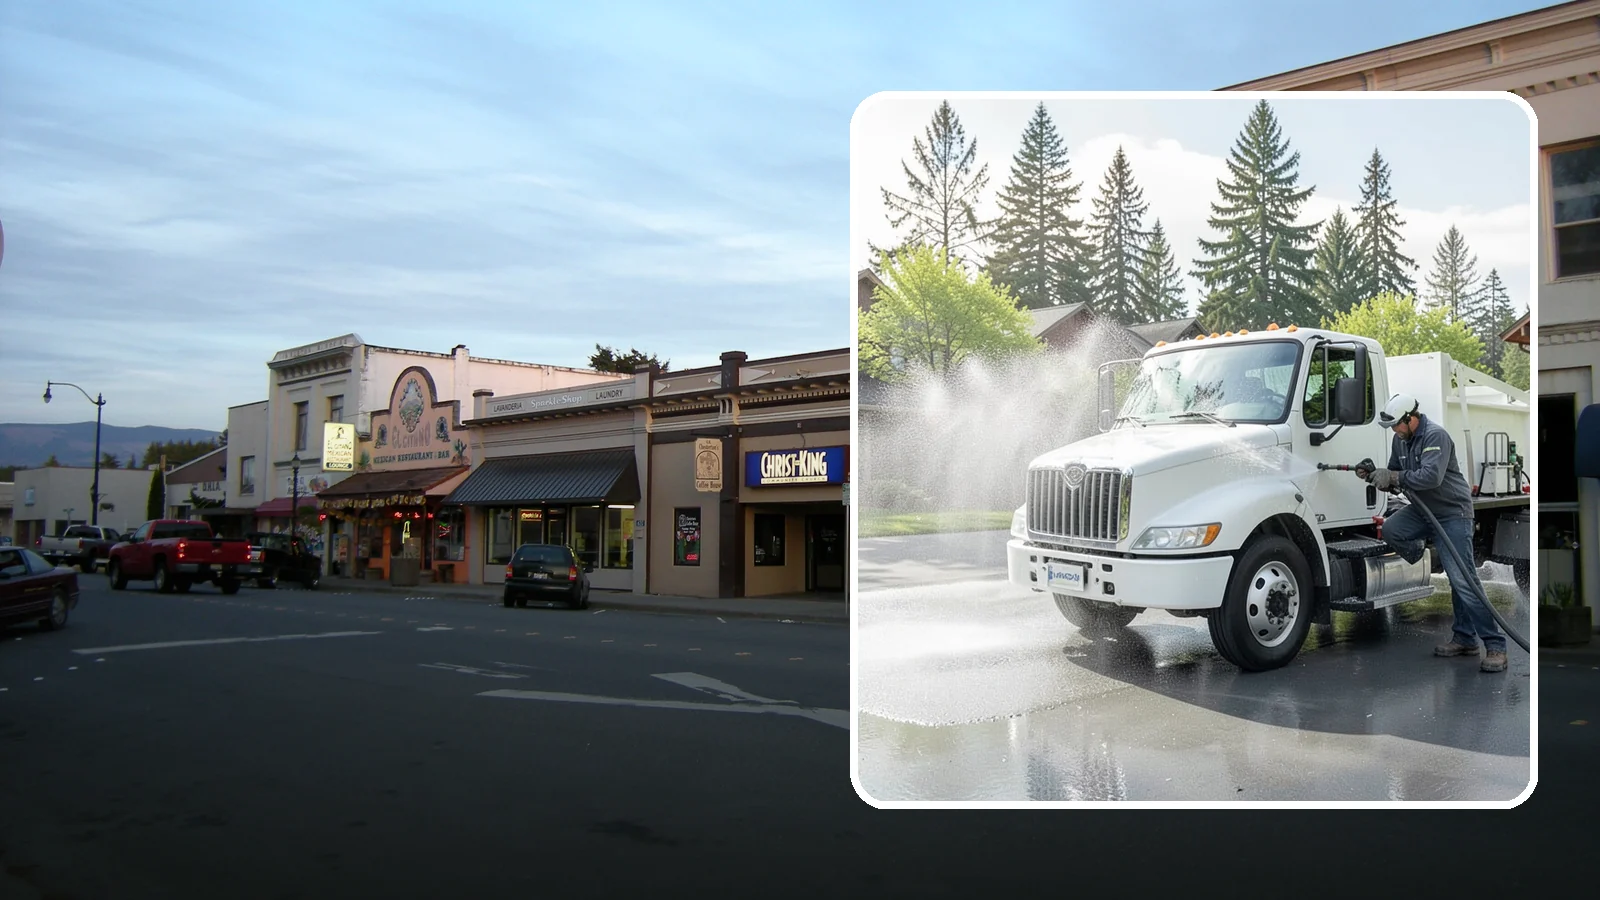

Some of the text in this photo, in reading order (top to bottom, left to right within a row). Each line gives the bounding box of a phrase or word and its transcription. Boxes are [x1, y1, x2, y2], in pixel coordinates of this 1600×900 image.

[561, 394, 582, 406] Shop
[595, 389, 624, 400] LAUNDRY
[493, 402, 522, 413] LAVANDERIA
[373, 450, 450, 464] MEXICAN RESTAURANT BAR
[761, 450, 828, 478] CHRIST KING
[696, 480, 709, 489] Coffee
